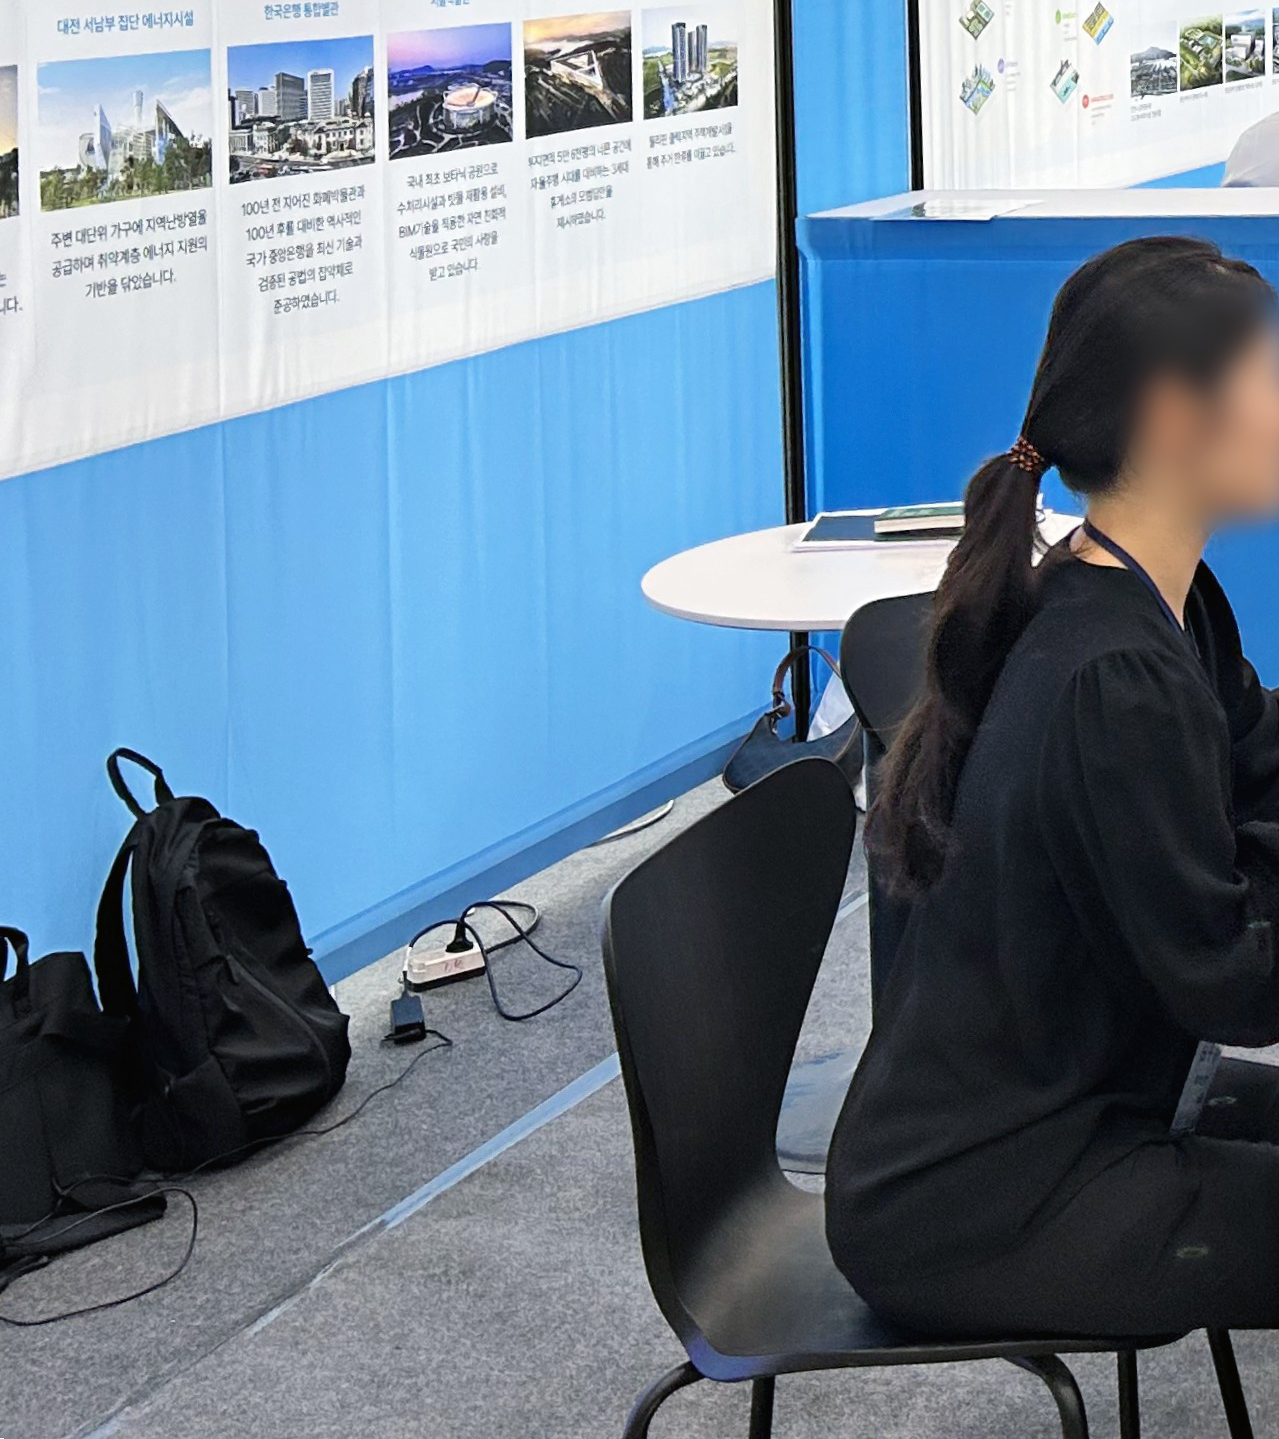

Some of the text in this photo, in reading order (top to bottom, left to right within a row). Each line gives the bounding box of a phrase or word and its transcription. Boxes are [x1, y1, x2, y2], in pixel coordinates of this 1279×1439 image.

[56, 10, 194, 35] 대전 서남부 집단 에너지시설
[264, 4, 302, 20] 한국은행
[51, 209, 207, 248] 주변 대단위 가구에 지역난방열을
[246, 221, 275, 240] 100년
[296, 216, 325, 234] 대비한
[326, 212, 362, 230] 역사적인
[52, 237, 208, 278] 공급하며 취약계층 에너지 지원의
[85, 270, 176, 298] 기반을 닦았습니다.
